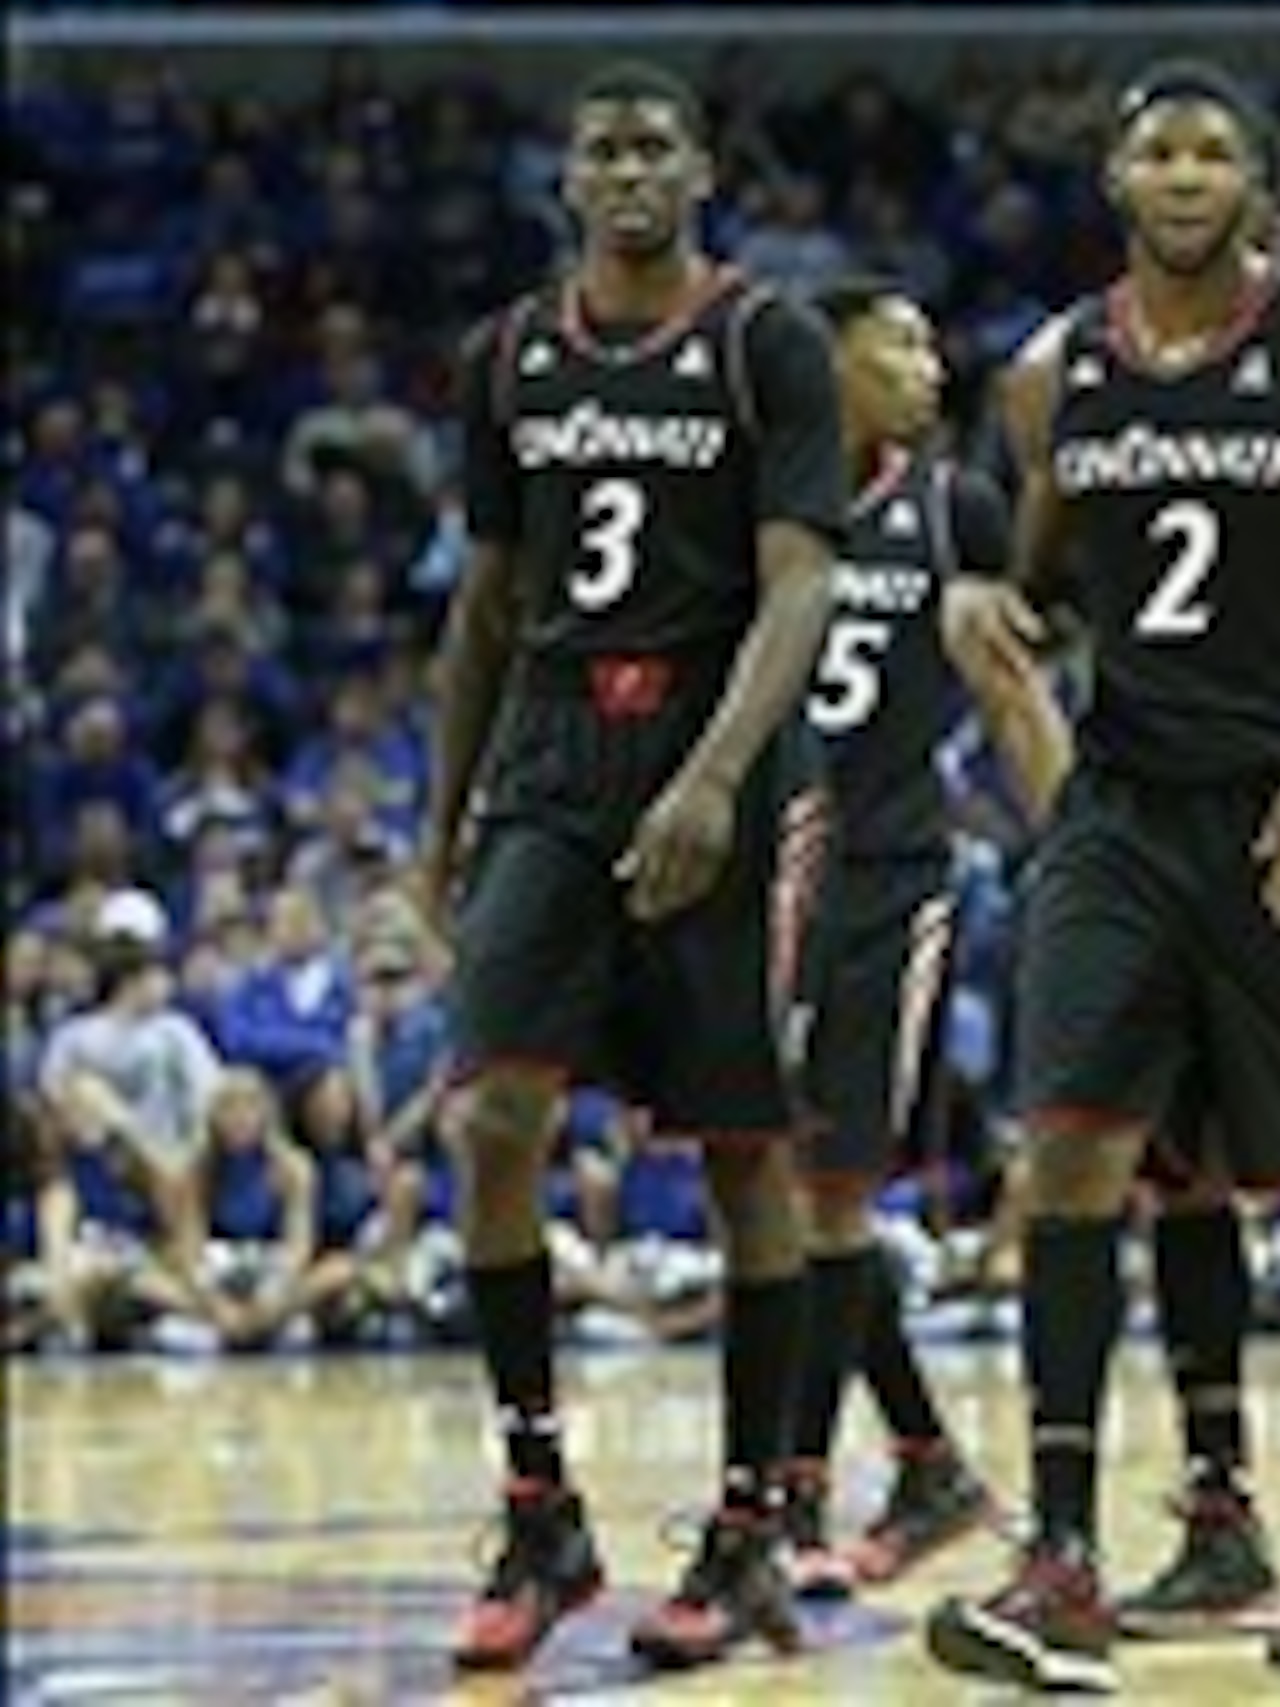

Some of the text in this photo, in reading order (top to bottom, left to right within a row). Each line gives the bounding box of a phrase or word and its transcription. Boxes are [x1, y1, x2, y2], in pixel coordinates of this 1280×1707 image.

[570, 479, 645, 608] 3
[1134, 500, 1219, 635] 2
[806, 619, 890, 730] 5
